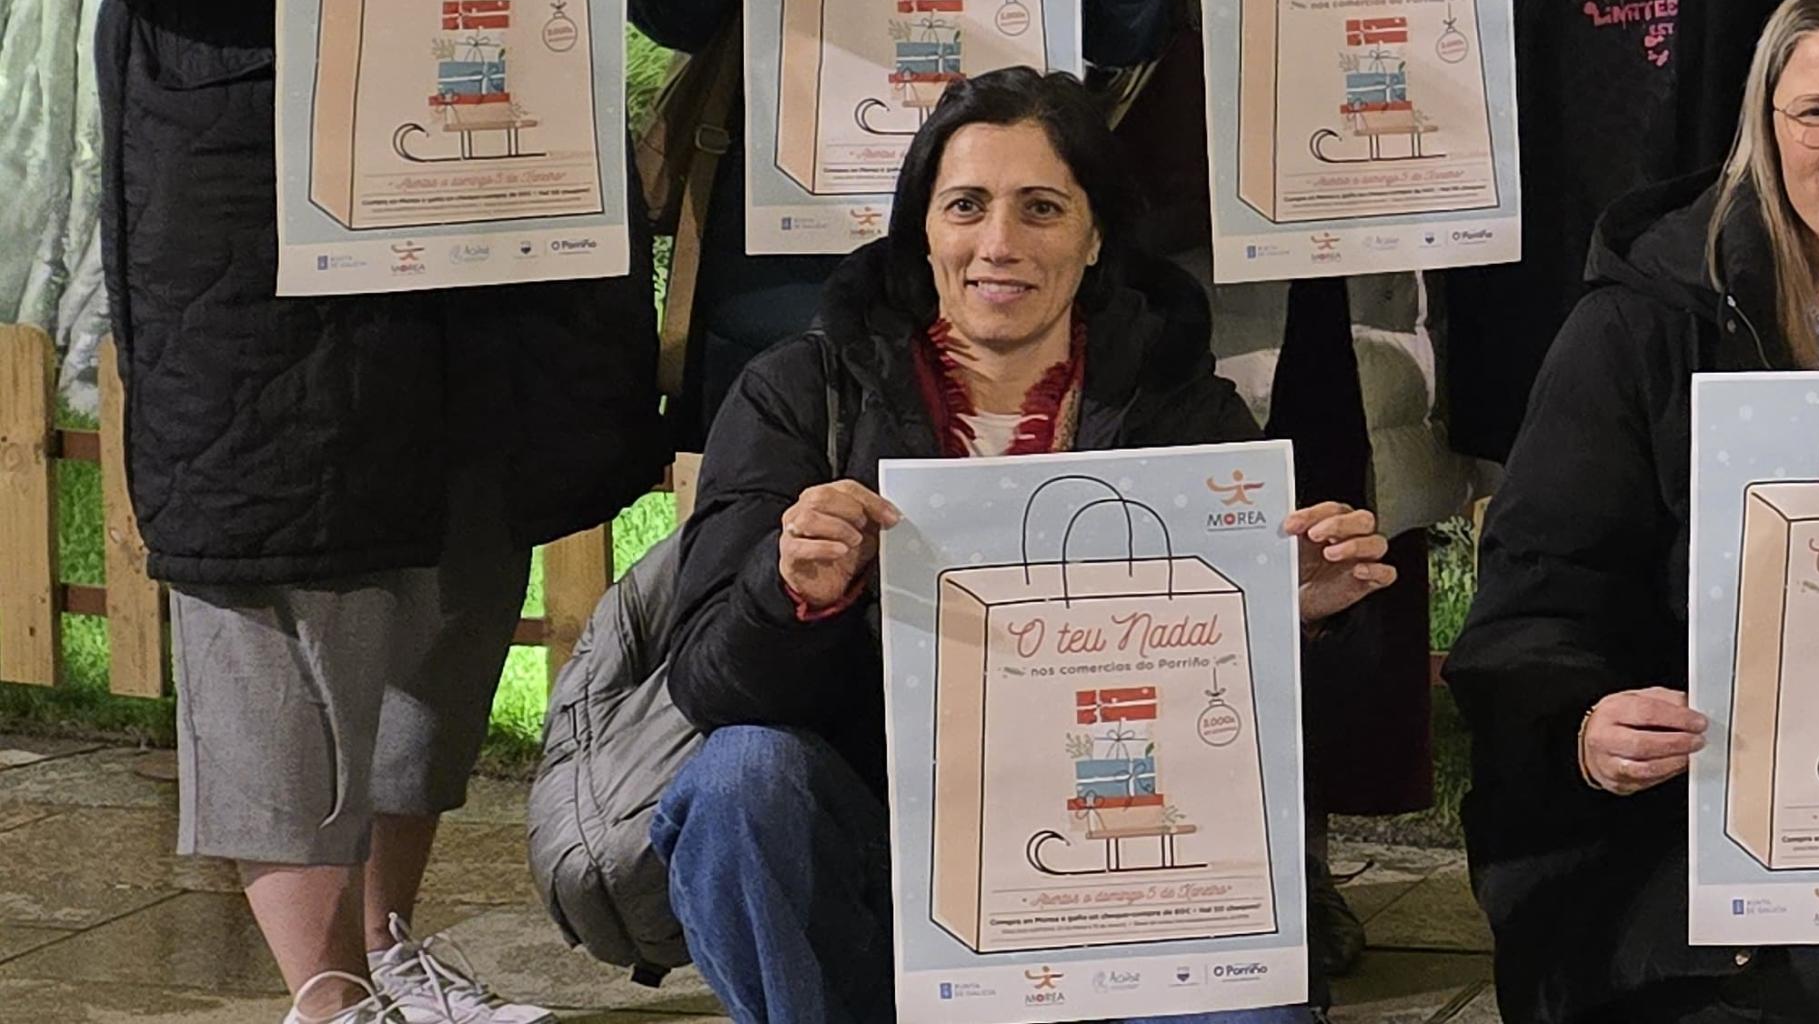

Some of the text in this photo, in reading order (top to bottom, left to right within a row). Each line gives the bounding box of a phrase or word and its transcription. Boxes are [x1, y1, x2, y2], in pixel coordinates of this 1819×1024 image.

[1207, 511, 1266, 526] MOREA
[1008, 612, 1223, 659] O teu Nadal
[1030, 656, 1210, 677] nos comercios do Porriño
[1214, 963, 1267, 977] O Porriño
